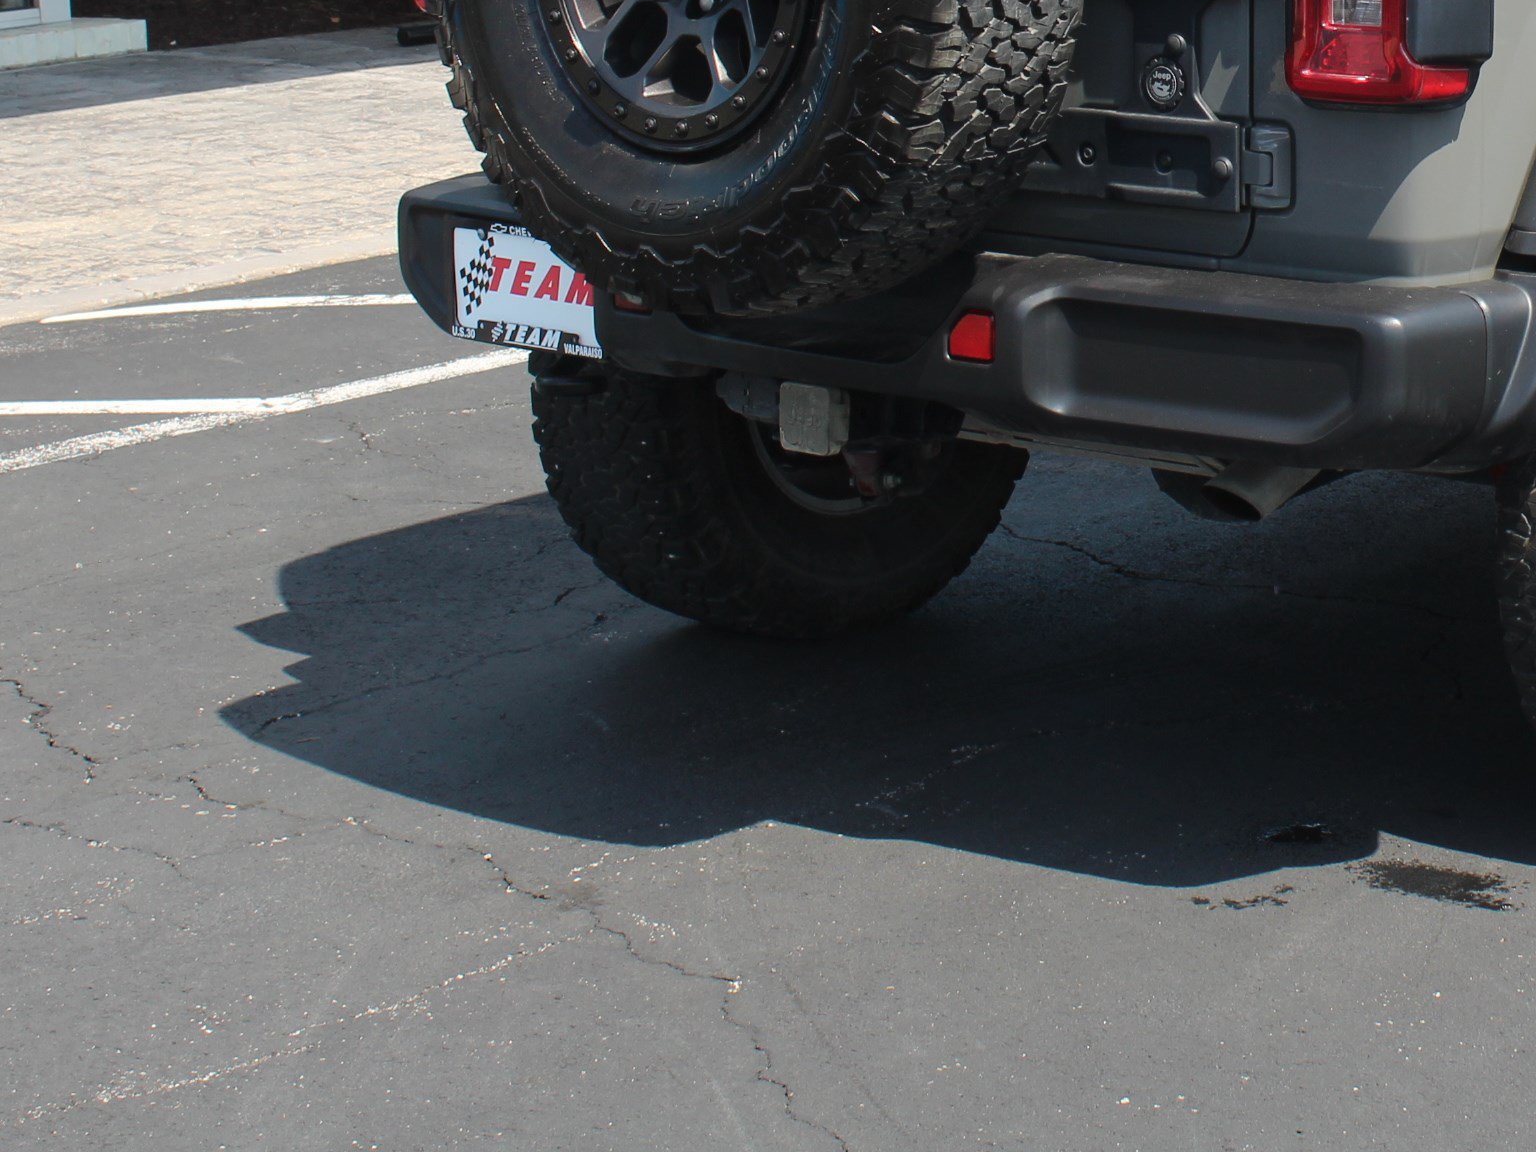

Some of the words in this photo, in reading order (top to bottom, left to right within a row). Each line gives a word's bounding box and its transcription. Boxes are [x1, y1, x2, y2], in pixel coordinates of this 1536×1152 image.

[1153, 71, 1171, 80] Jeep
[489, 257, 594, 306] TEAM
[504, 322, 562, 348] TEAM
[564, 343, 603, 359] VALPARAISO
